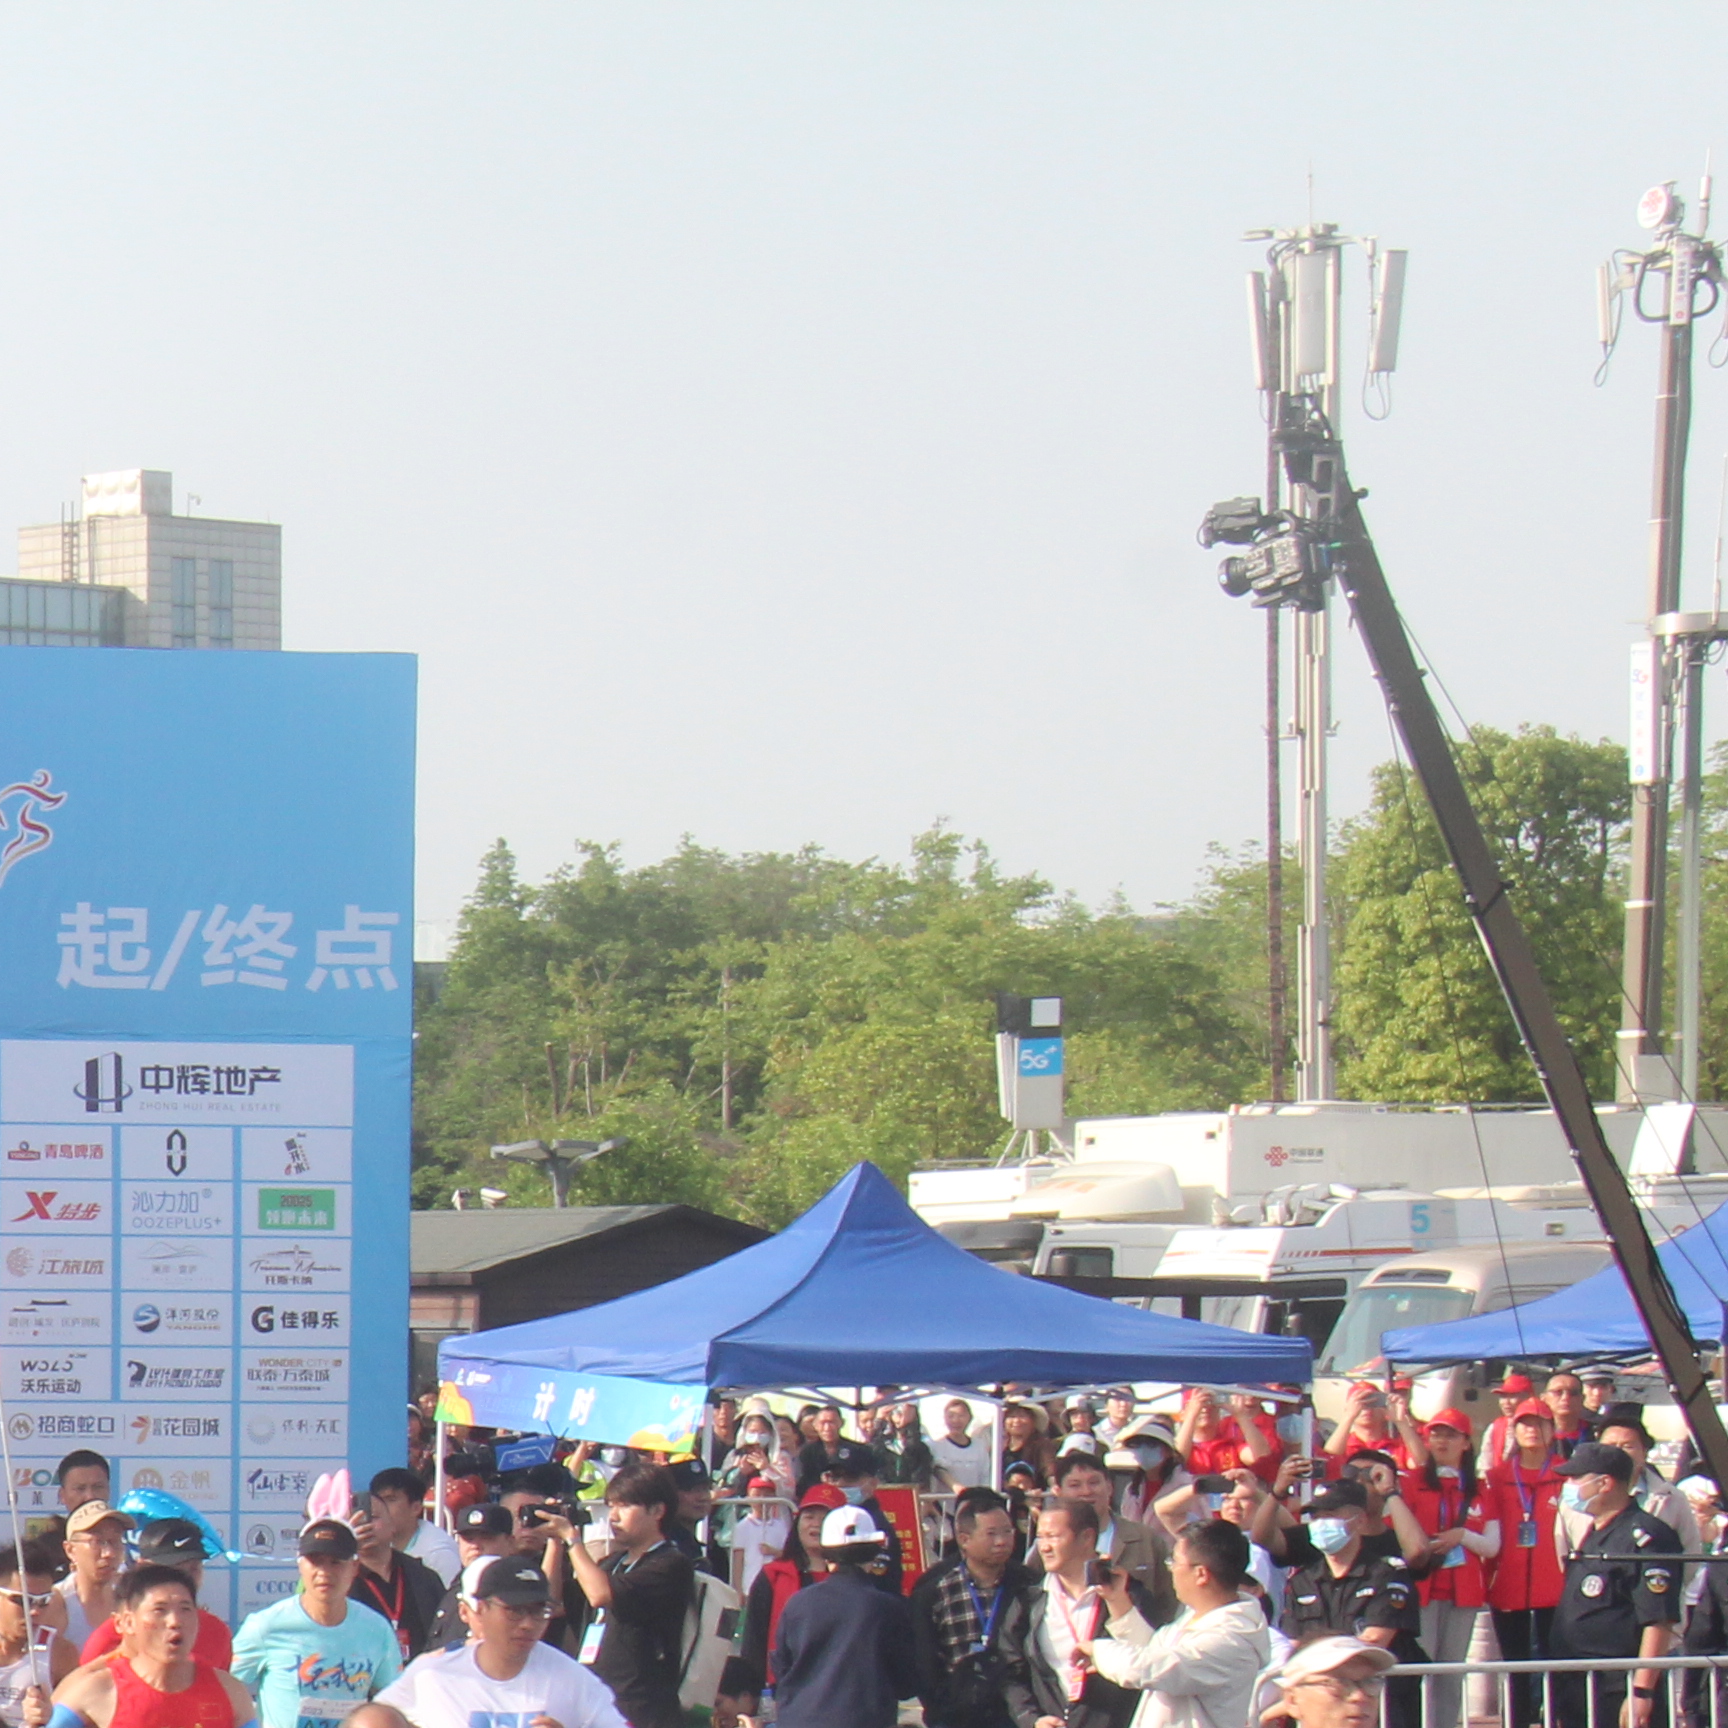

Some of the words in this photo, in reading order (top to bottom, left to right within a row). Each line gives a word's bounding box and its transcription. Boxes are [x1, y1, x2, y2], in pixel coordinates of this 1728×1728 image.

[55, 902, 400, 992] 起/终点
[140, 1064, 281, 1097] 中辉地产
[139, 1101, 179, 1112] ZHONG
[182, 1102, 204, 1112] HUI
[207, 1102, 236, 1112] REAL
[240, 1103, 282, 1113] ESTATE
[44, 1143, 104, 1160] 青岛啤酒
[54, 1203, 102, 1221] 特步
[1410, 1204, 1431, 1234] 5
[38, 1259, 105, 1276] 江旅城
[280, 1310, 340, 1330] 佳得乐
[20, 1378, 82, 1395] 沃乐运动
[37, 1415, 115, 1434] 招商蛇口
[162, 1417, 221, 1437] 花园城
